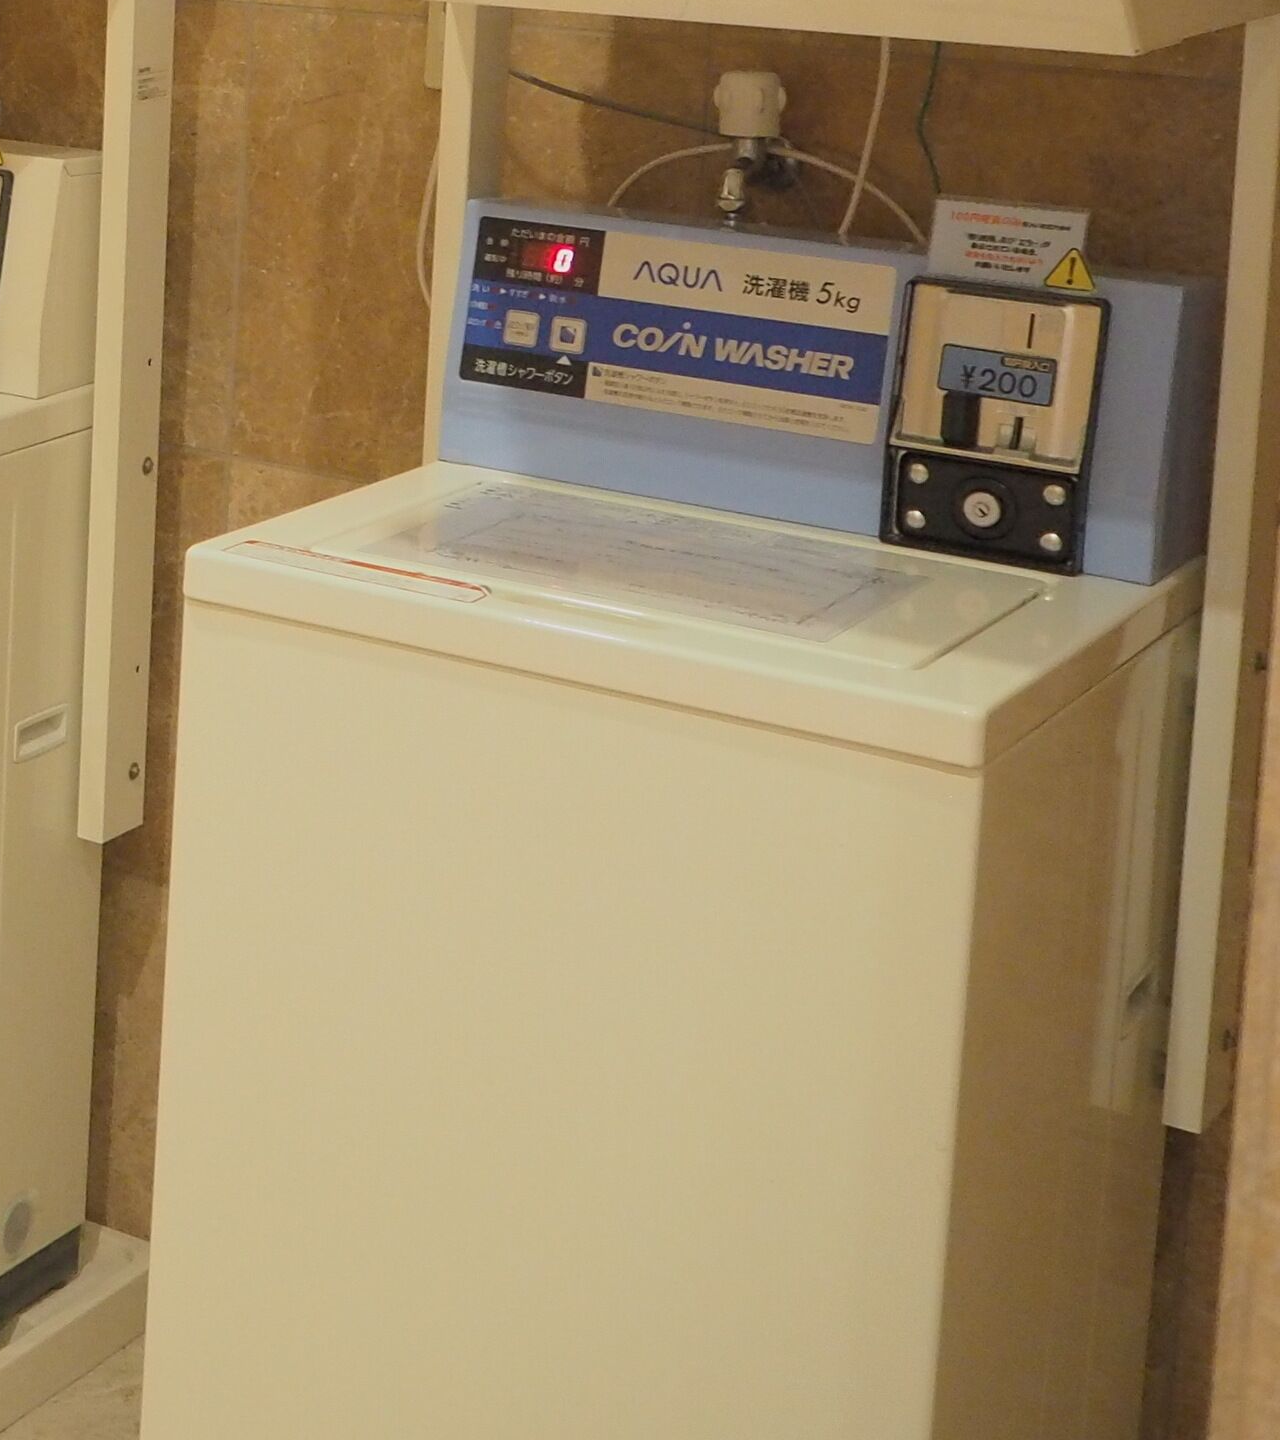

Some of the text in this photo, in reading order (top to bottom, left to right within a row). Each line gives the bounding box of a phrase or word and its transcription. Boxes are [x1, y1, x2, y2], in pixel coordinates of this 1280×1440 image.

[579, 236, 590, 247] 円
[553, 248, 574, 273] 0
[633, 261, 723, 292] AQUA
[742, 273, 860, 314] 洗濯機 5kg
[474, 358, 574, 385] 洗濯槽シャワーボタン
[714, 338, 855, 380] WASHER
[960, 364, 1038, 399] ¥200
